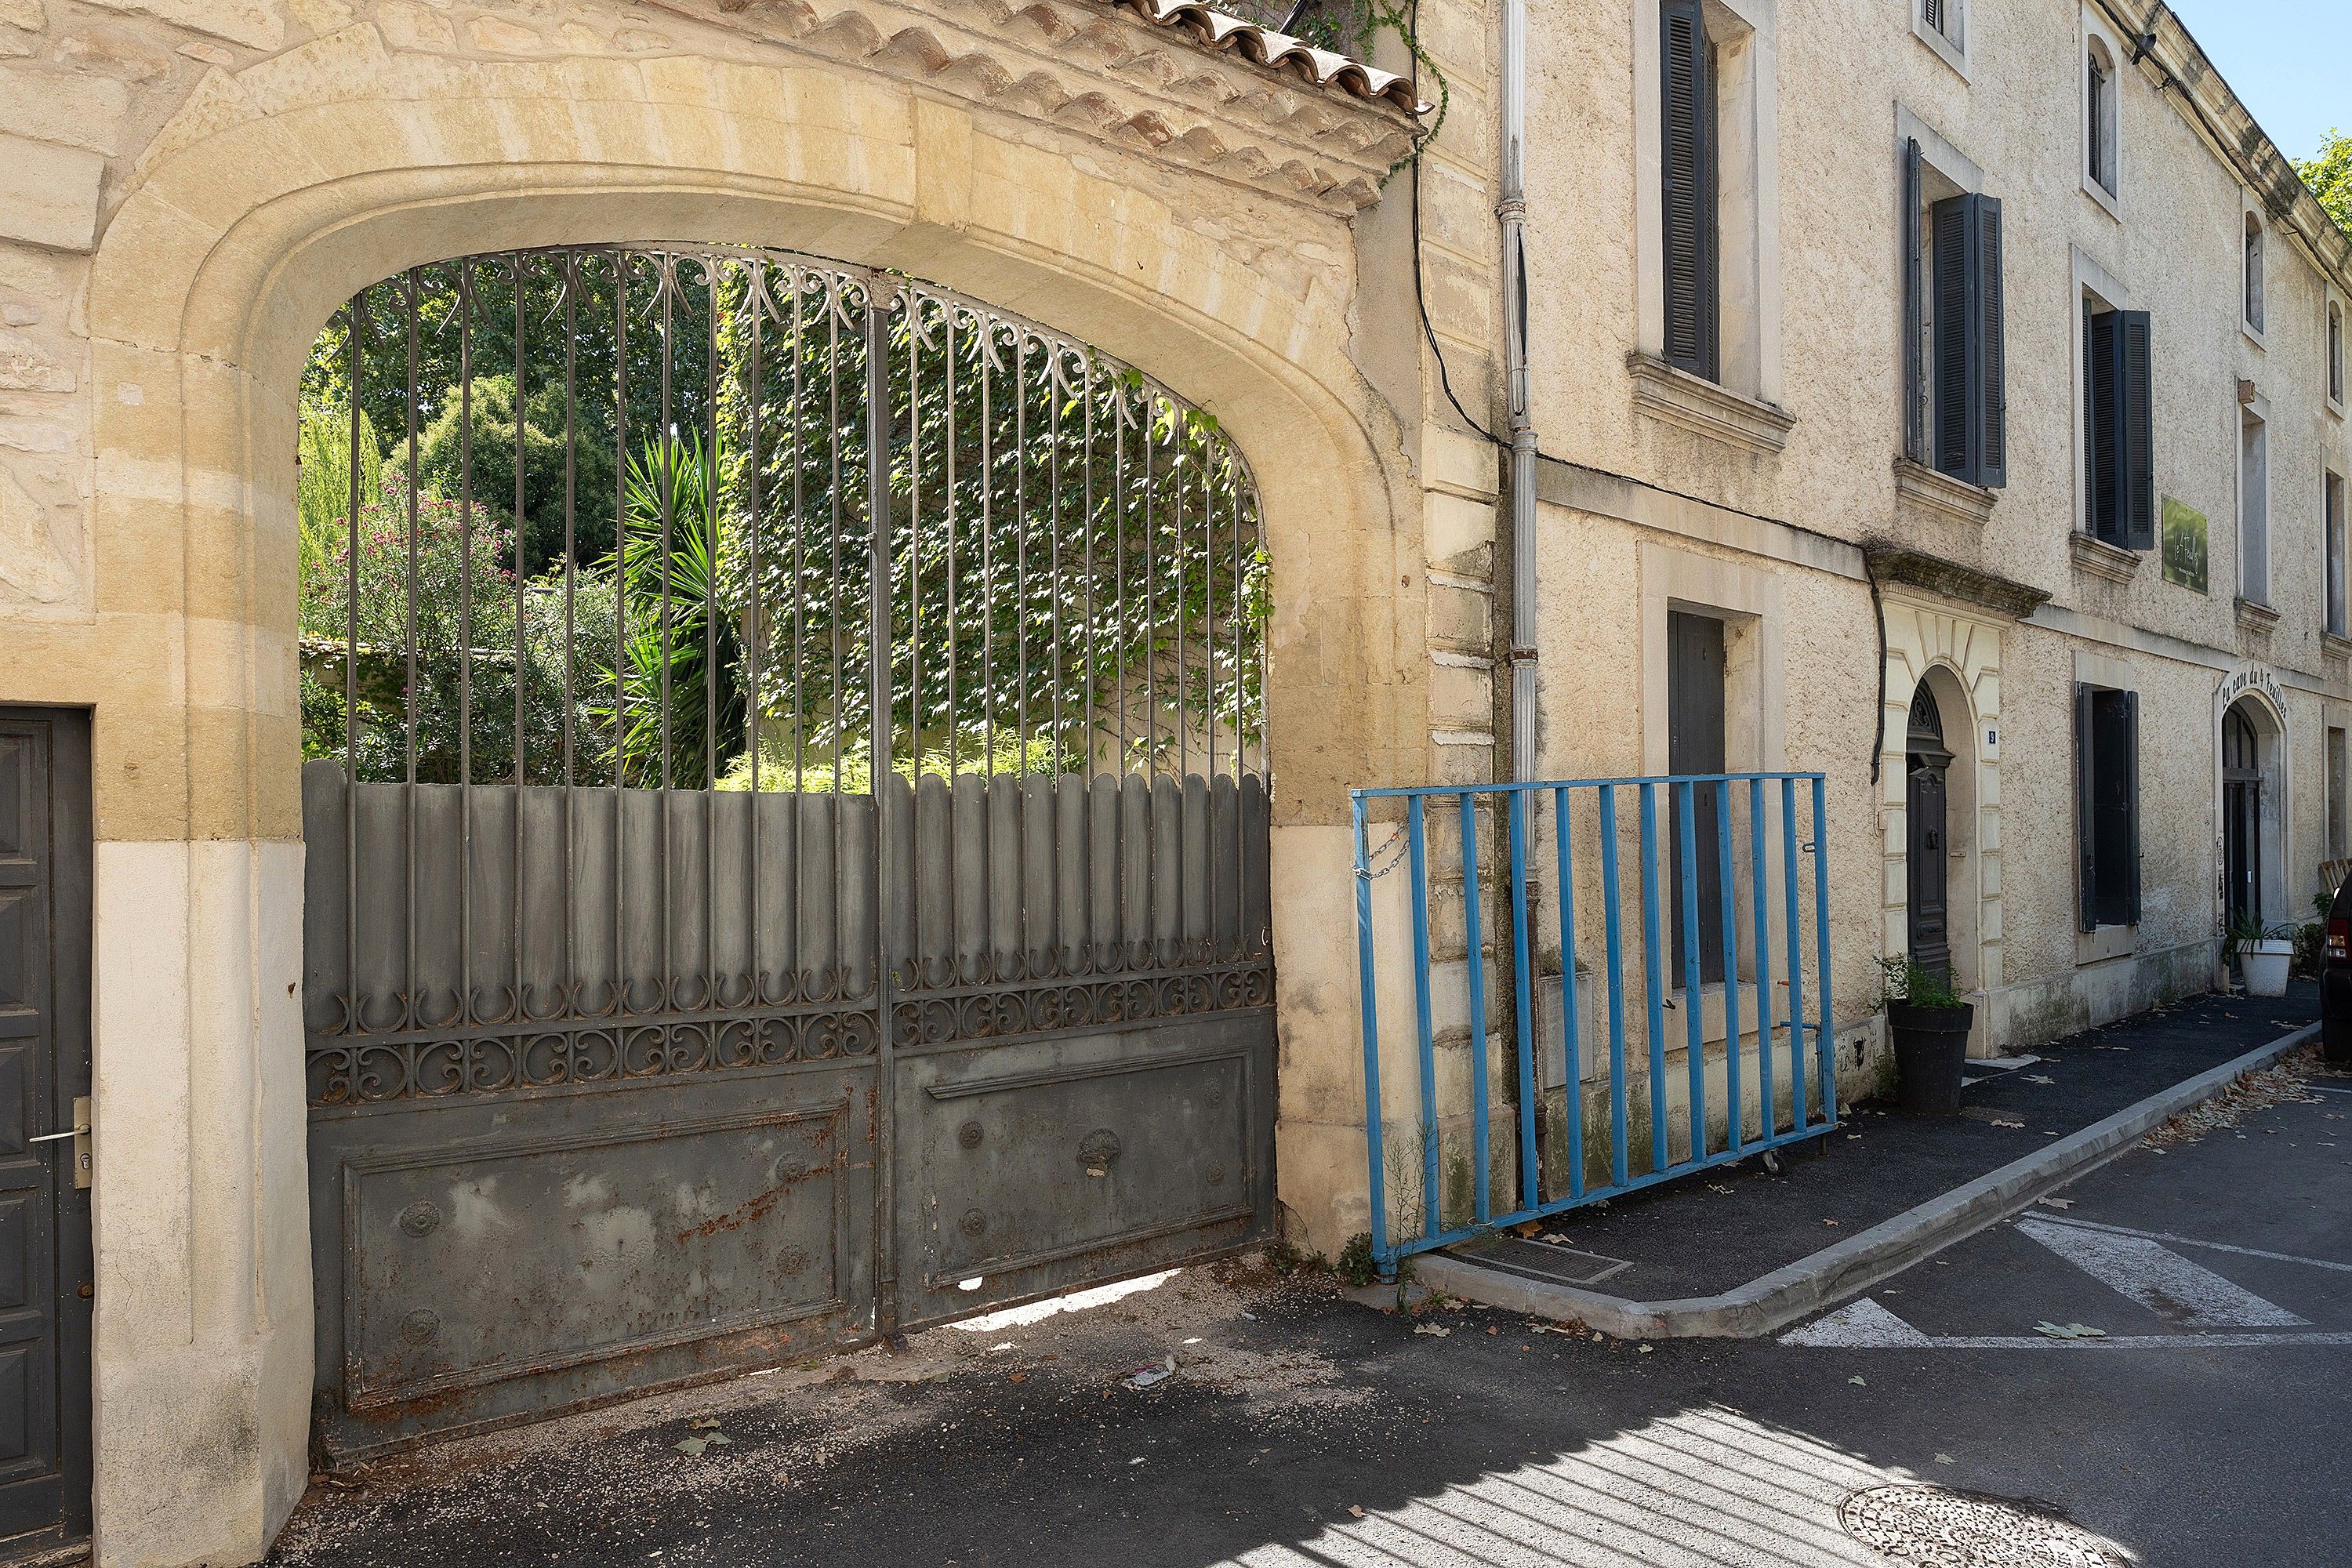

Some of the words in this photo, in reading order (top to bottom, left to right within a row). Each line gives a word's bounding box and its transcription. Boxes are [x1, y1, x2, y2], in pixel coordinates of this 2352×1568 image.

[2223, 686, 2230, 711] La
[2232, 672, 2247, 695] cave
[2249, 662, 2258, 684] du
[2259, 668, 2264, 687] 4
[2266, 672, 2287, 719] Feuilles
